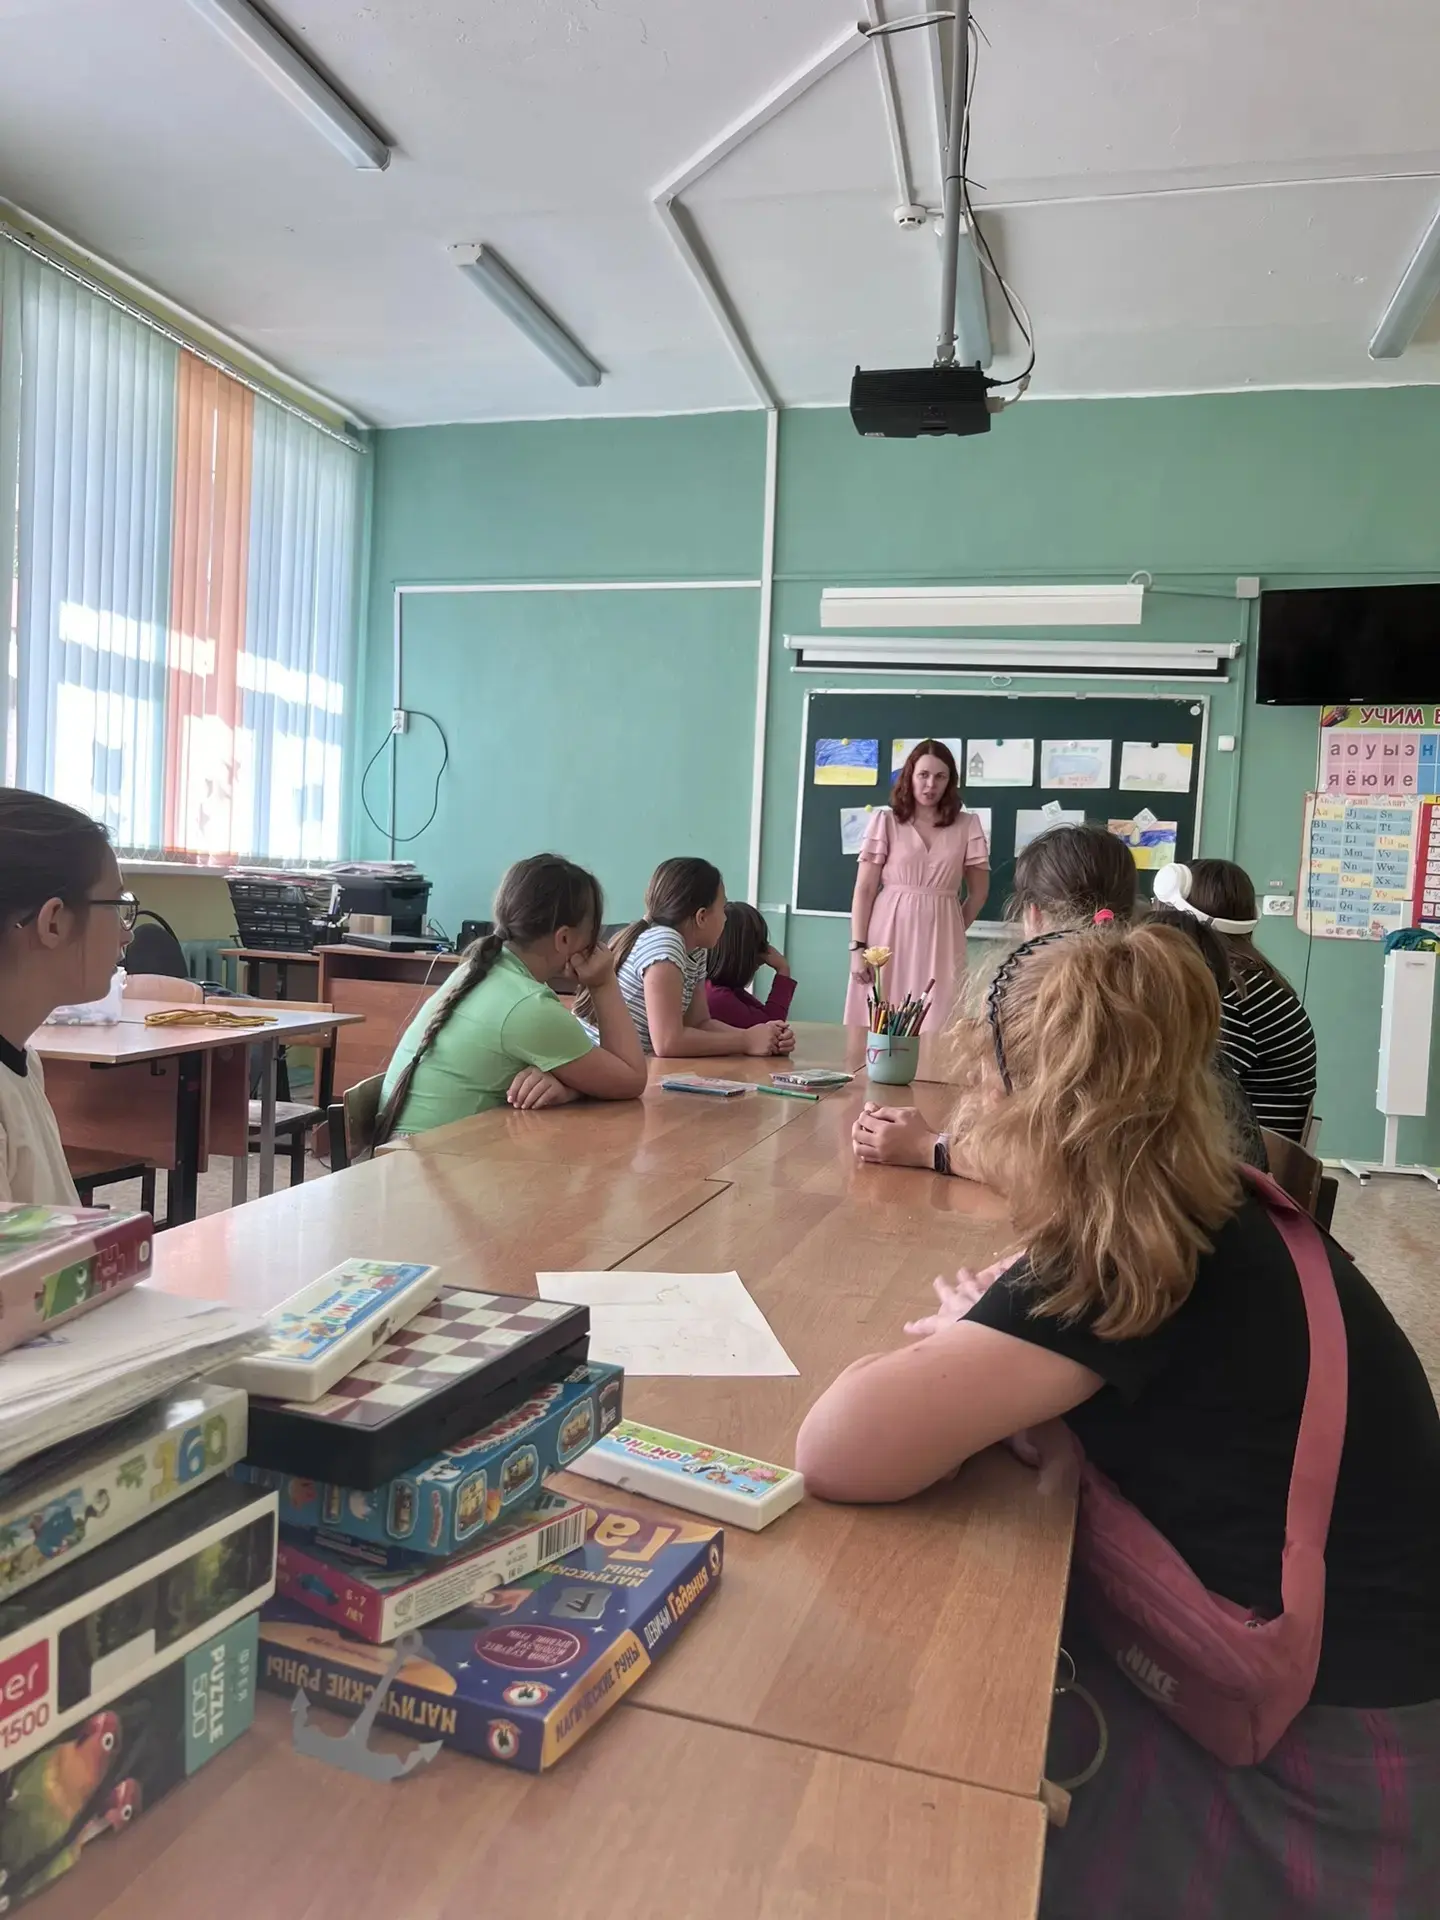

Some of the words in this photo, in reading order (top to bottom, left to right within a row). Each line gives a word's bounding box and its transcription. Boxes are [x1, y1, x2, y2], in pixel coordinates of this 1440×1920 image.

[1360, 707, 1424, 726] УЧИМ
[1330, 744, 1340, 756] а
[1347, 744, 1358, 756] о
[1365, 744, 1377, 759] у
[1384, 744, 1399, 756] ы
[1404, 744, 1415, 756] э
[1422, 744, 1433, 756] н
[1329, 774, 1339, 786] я
[1346, 770, 1356, 786] ё
[1362, 774, 1377, 786] ю
[1384, 774, 1394, 786] и
[1403, 774, 1413, 786] е
[1346, 821, 1361, 830] Kk
[1379, 823, 1391, 832] Tt
[1344, 848, 1363, 857] Mm
[1378, 849, 1391, 858] Vv
[1343, 861, 1357, 870] Nn
[1376, 862, 1395, 871] Ww
[1375, 876, 1391, 885] Xx
[151, 1414, 228, 1501] 160
[614, 1435, 694, 1463] ДОМИНО
[586, 1508, 676, 1562] Га
[601, 1563, 654, 1578] РУНЫ
[667, 1565, 710, 1623] Гадания
[613, 1641, 641, 1680] РУНЫ
[0, 1661, 39, 1706] er
[266, 1654, 322, 1693] РУНЫ
[1124, 1643, 1184, 1702] NIKE
[209, 1643, 226, 1744] PUZZLE
[192, 1672, 208, 1739] 500
[0, 1701, 50, 1749] 1500
